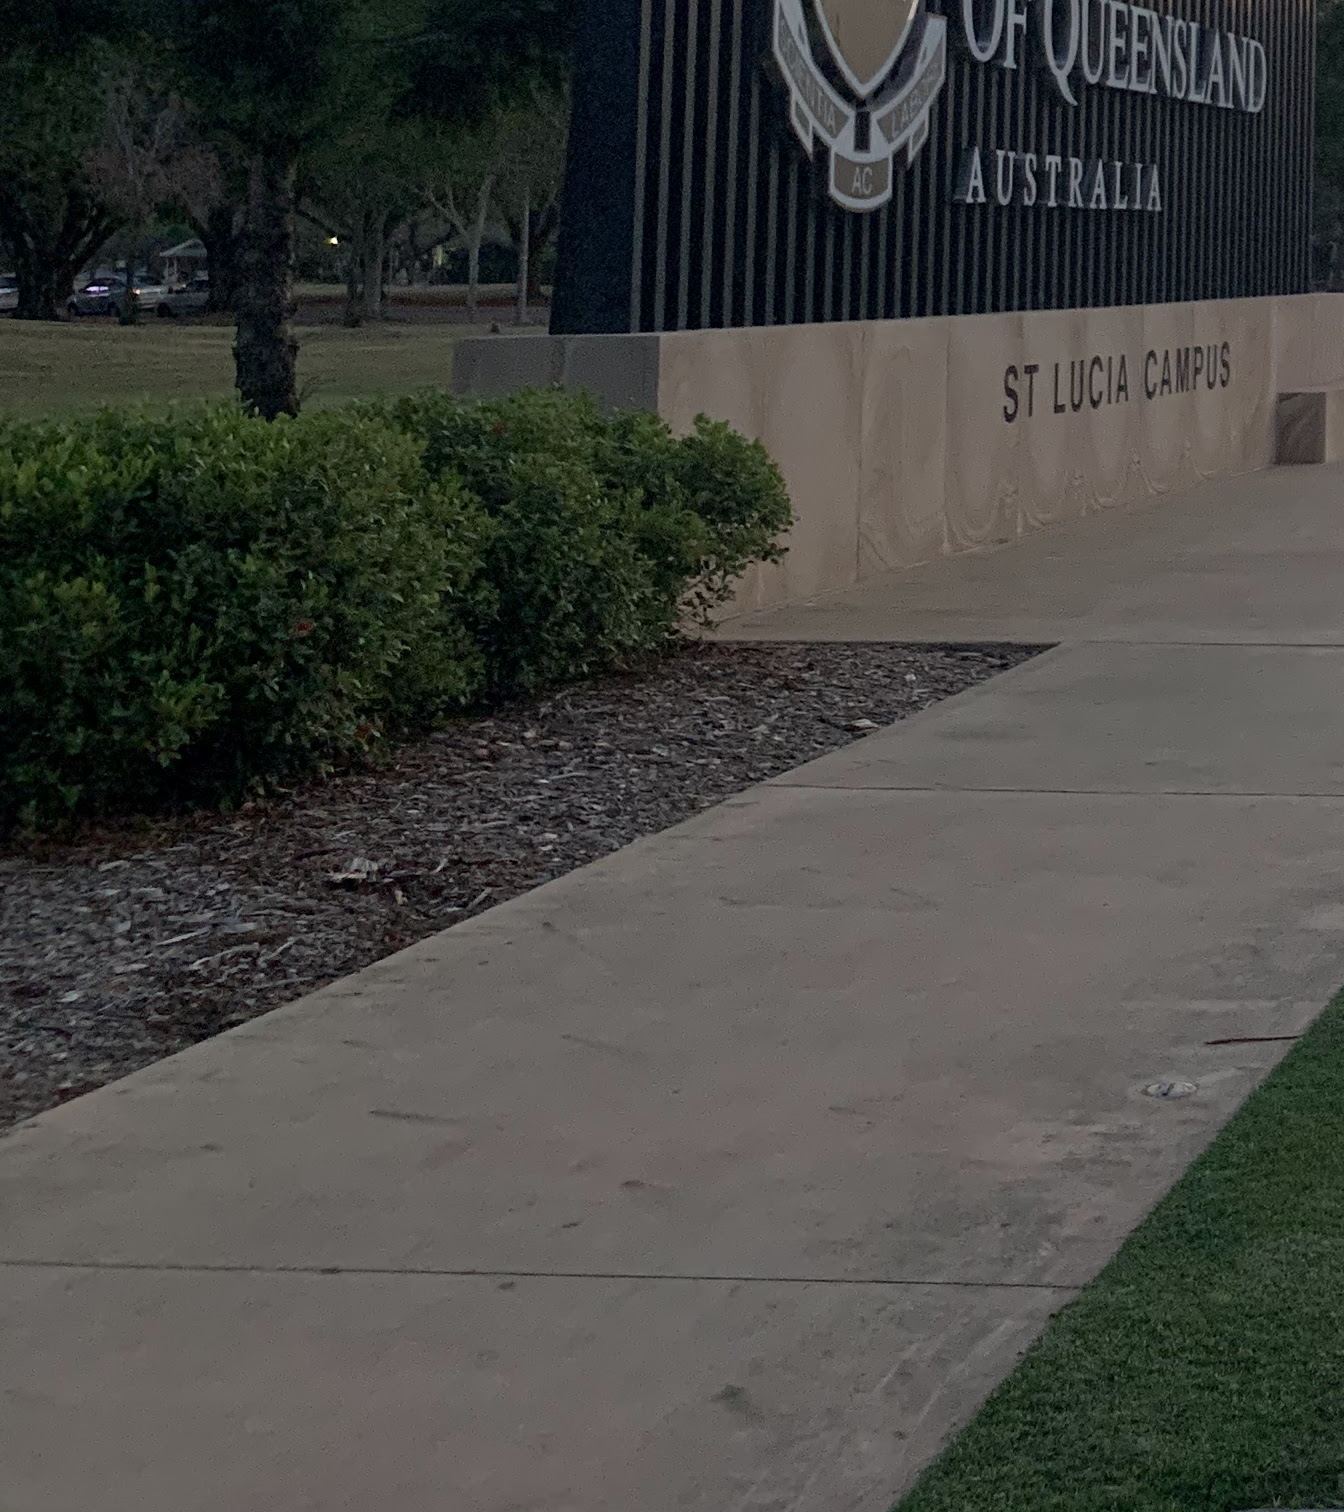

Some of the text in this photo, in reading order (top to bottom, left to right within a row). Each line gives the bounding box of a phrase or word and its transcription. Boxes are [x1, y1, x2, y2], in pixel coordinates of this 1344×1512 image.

[851, 166, 873, 195] AC
[965, 146, 1162, 211] AUSTRALIA
[1003, 341, 1231, 423] ST LUCIA CAMPUS
